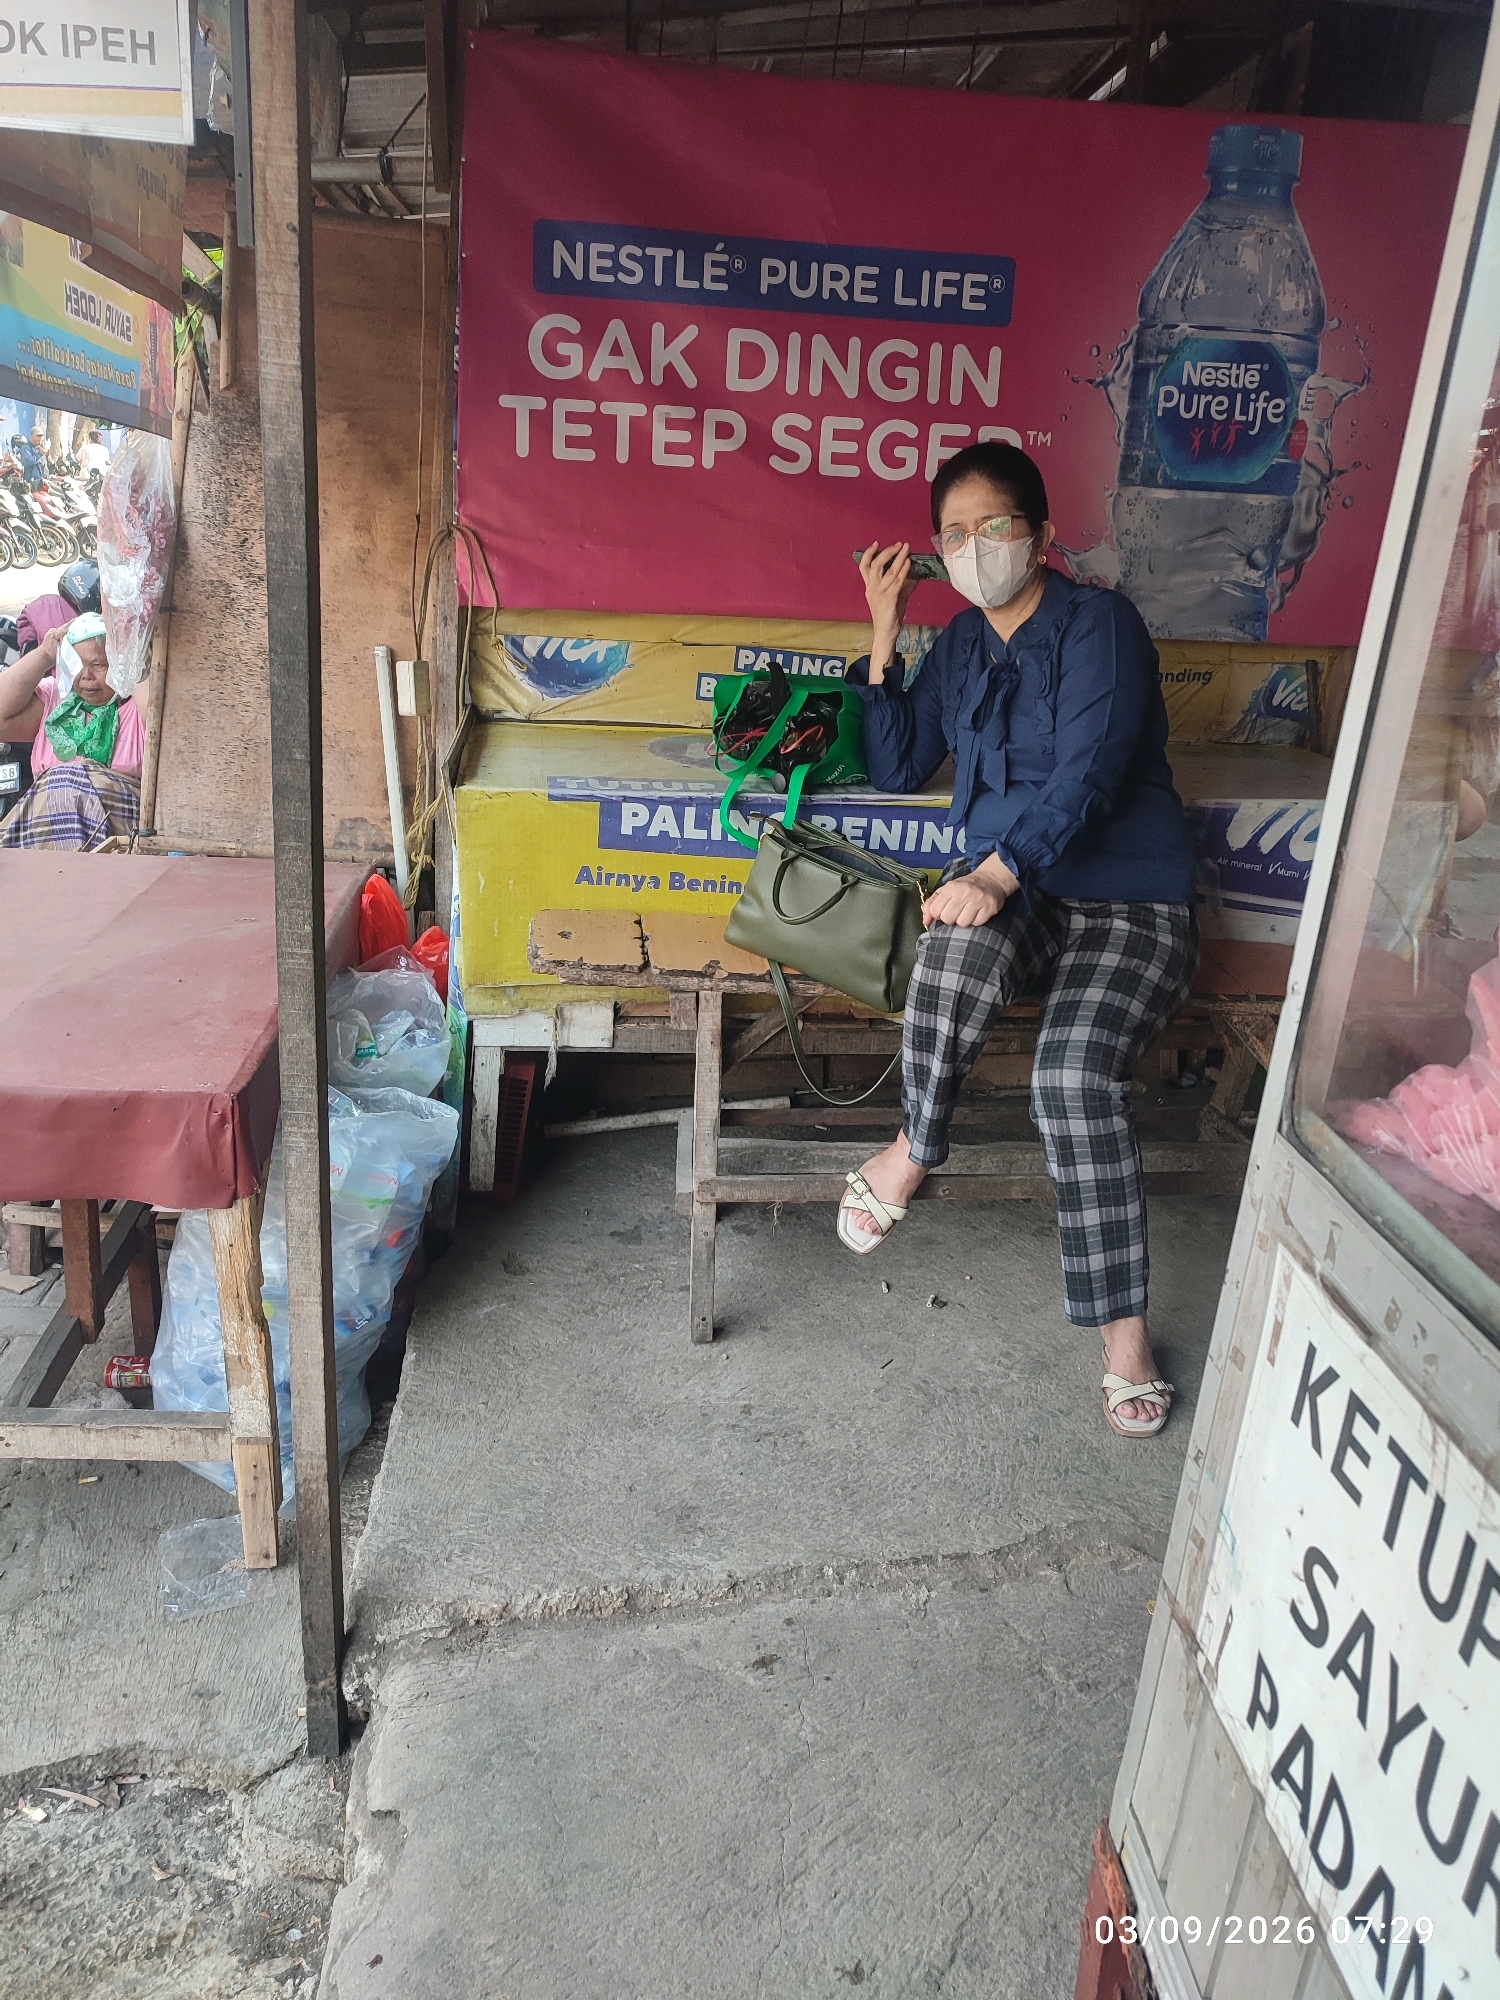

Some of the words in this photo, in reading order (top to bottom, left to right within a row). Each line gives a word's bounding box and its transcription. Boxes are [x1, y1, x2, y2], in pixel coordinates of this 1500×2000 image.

[61, 23, 157, 66] IPEH
[759, 257, 879, 303] PURE
[527, 313, 699, 389] GAK
[725, 327, 1003, 408] DINGIN
[498, 394, 747, 470] TETEP
[1156, 385, 1230, 419] Pure
[1233, 389, 1285, 436] Life
[737, 648, 843, 678] PALING
[556, 778, 716, 791] TUTUP
[574, 865, 661, 893] Airnya
[668, 871, 745, 895] Benin
[1217, 856, 1228, 864] Air
[1230, 859, 1263, 872] mineral
